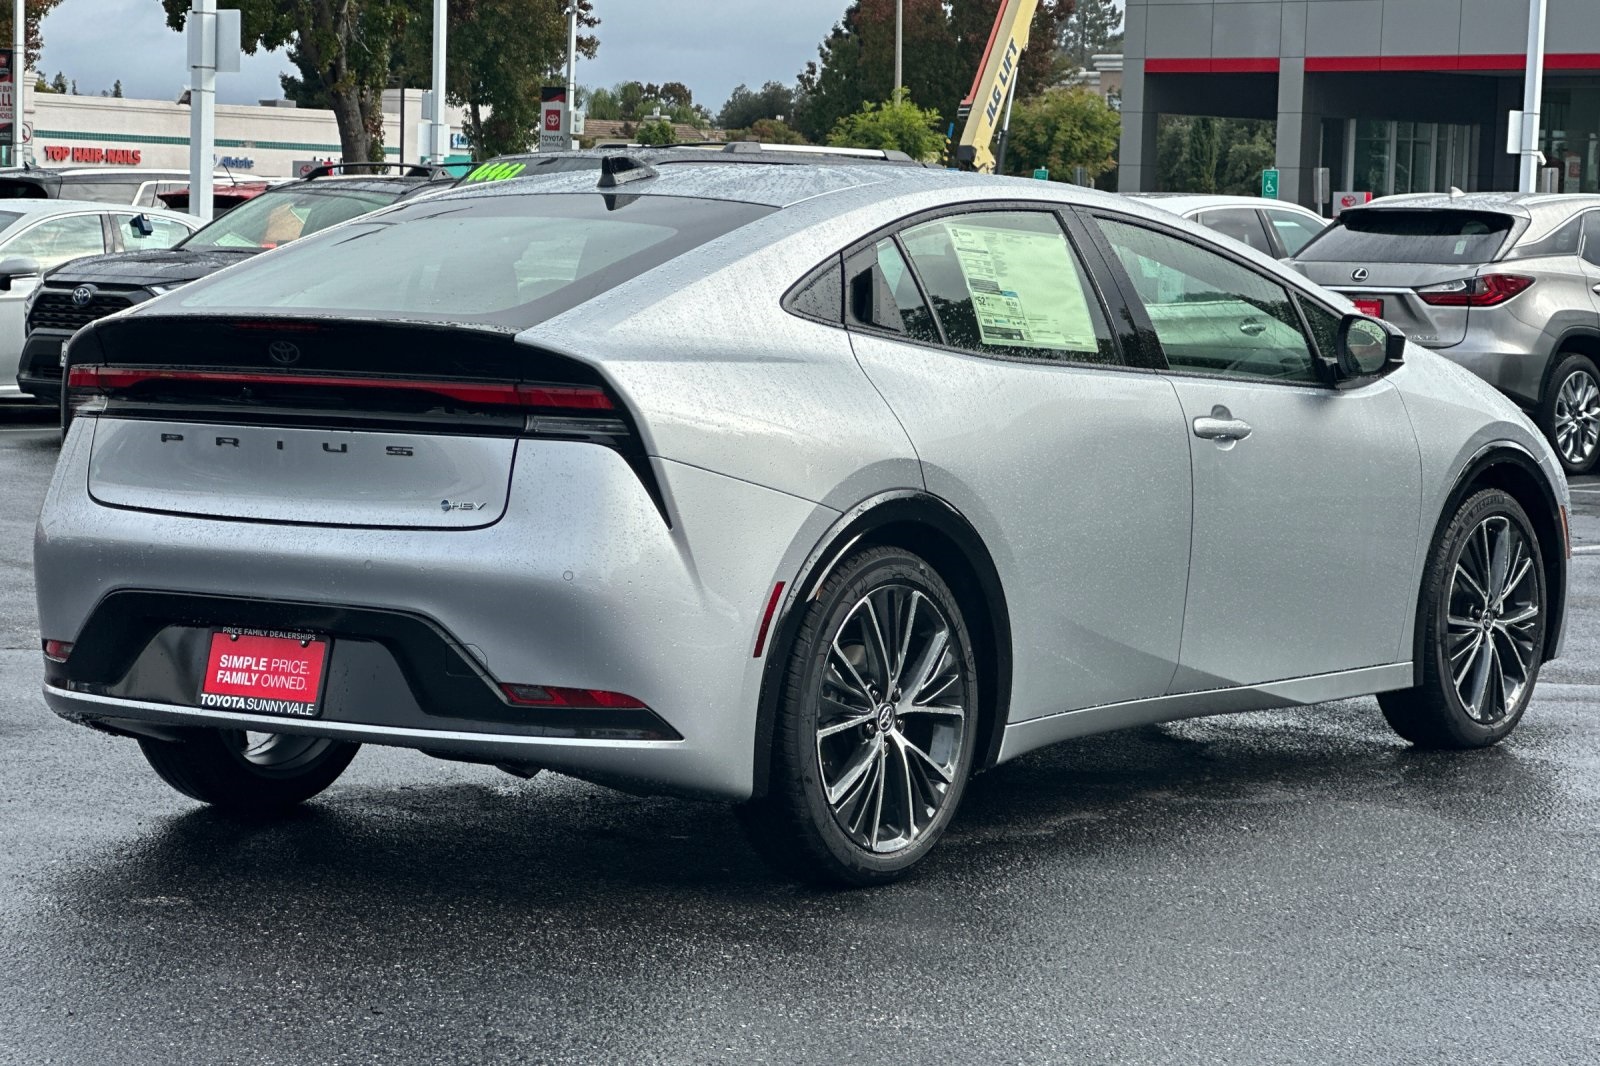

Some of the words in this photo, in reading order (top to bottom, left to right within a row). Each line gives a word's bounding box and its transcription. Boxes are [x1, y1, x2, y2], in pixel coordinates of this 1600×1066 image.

[987, 84, 1002, 128] JLG
[999, 37, 1018, 87] LIFT
[0, 93, 13, 107] LL
[45, 146, 70, 161] TOP
[161, 433, 414, 456] PRIUS
[450, 502, 487, 511] HEV
[222, 626, 243, 635] PRICE
[243, 628, 268, 637] FAMILY
[269, 630, 316, 641] DEALERSHIPS
[219, 654, 268, 671] SIMPLE
[270, 658, 310, 675] PRICE.
[216, 670, 259, 686] FAMILY
[260, 673, 307, 690] OWNED.
[200, 693, 245, 709] TOYOTA
[245, 697, 314, 716] SUNNYVALE
